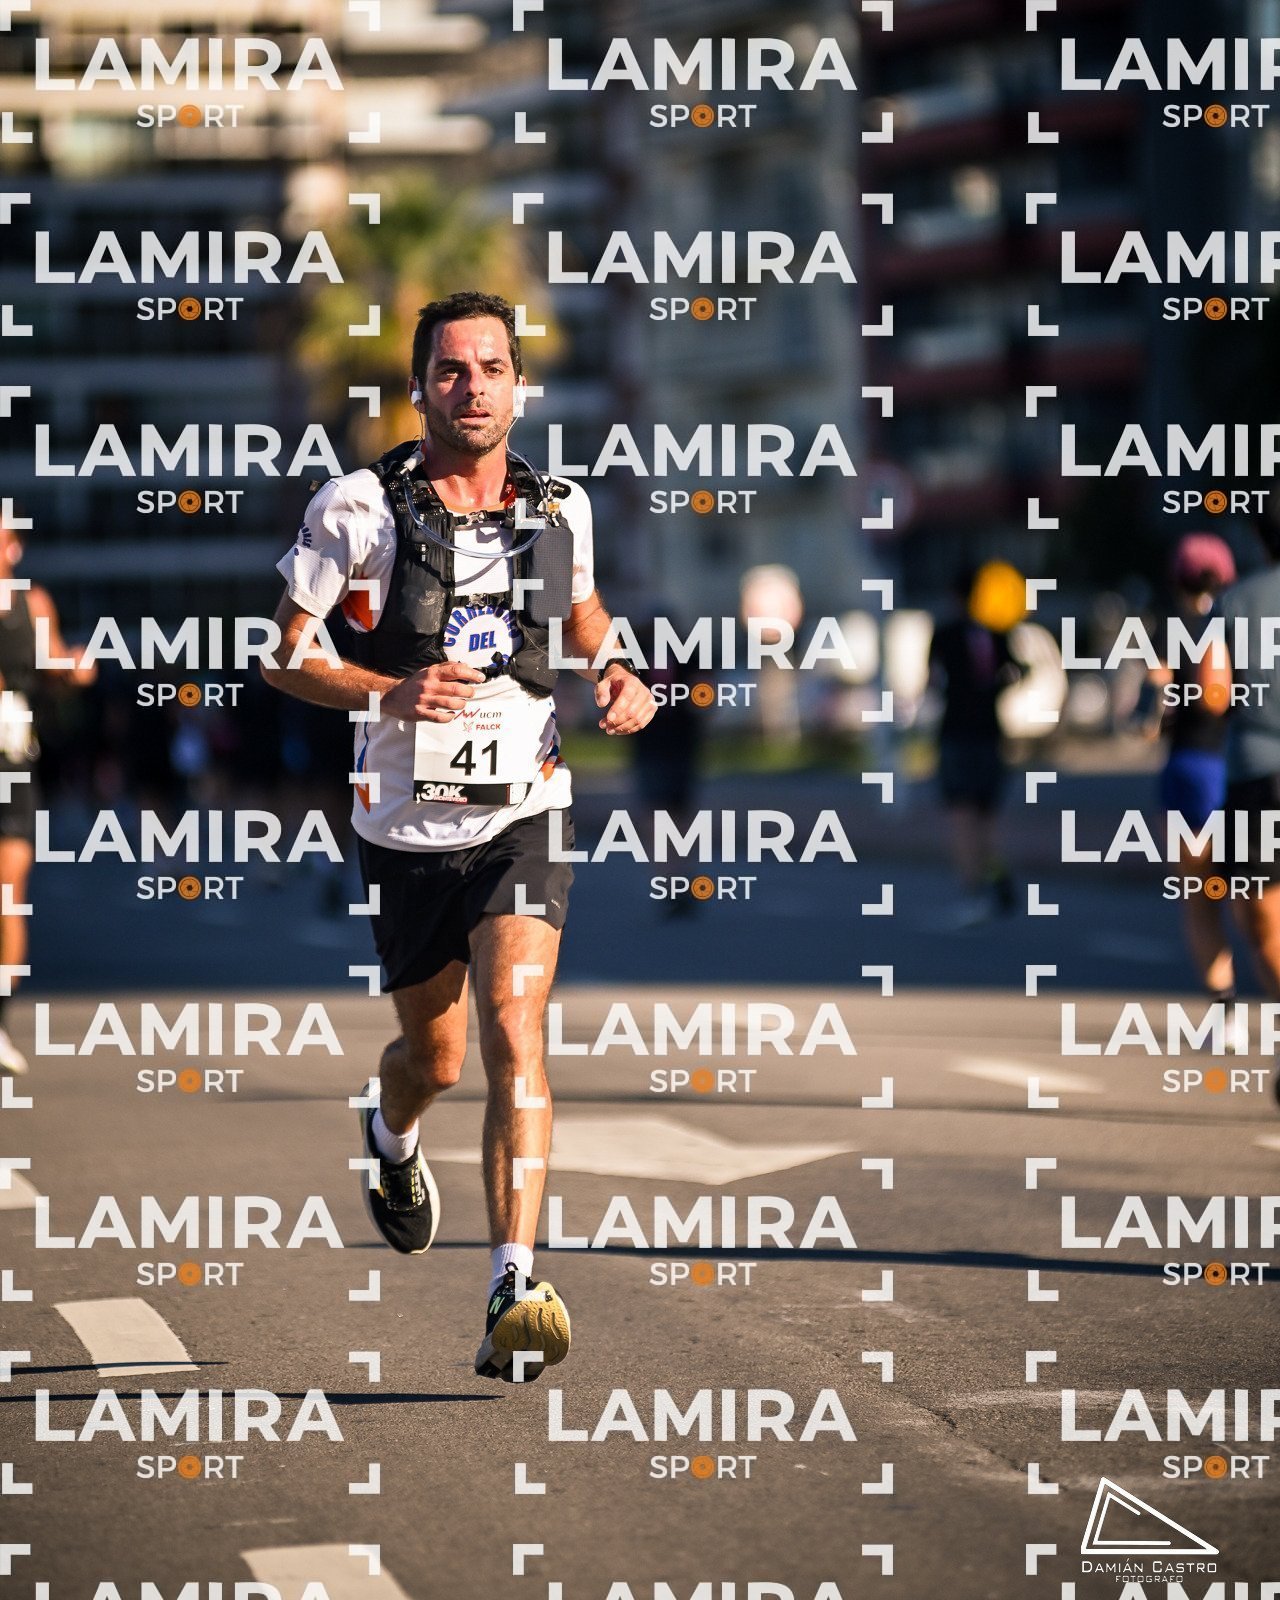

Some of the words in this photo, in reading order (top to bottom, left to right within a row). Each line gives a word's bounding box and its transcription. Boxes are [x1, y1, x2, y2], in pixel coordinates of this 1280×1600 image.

[468, 630, 497, 652] DEL
[480, 711, 502, 719] ucm
[450, 740, 498, 776] 41
[421, 783, 465, 801] 30K
